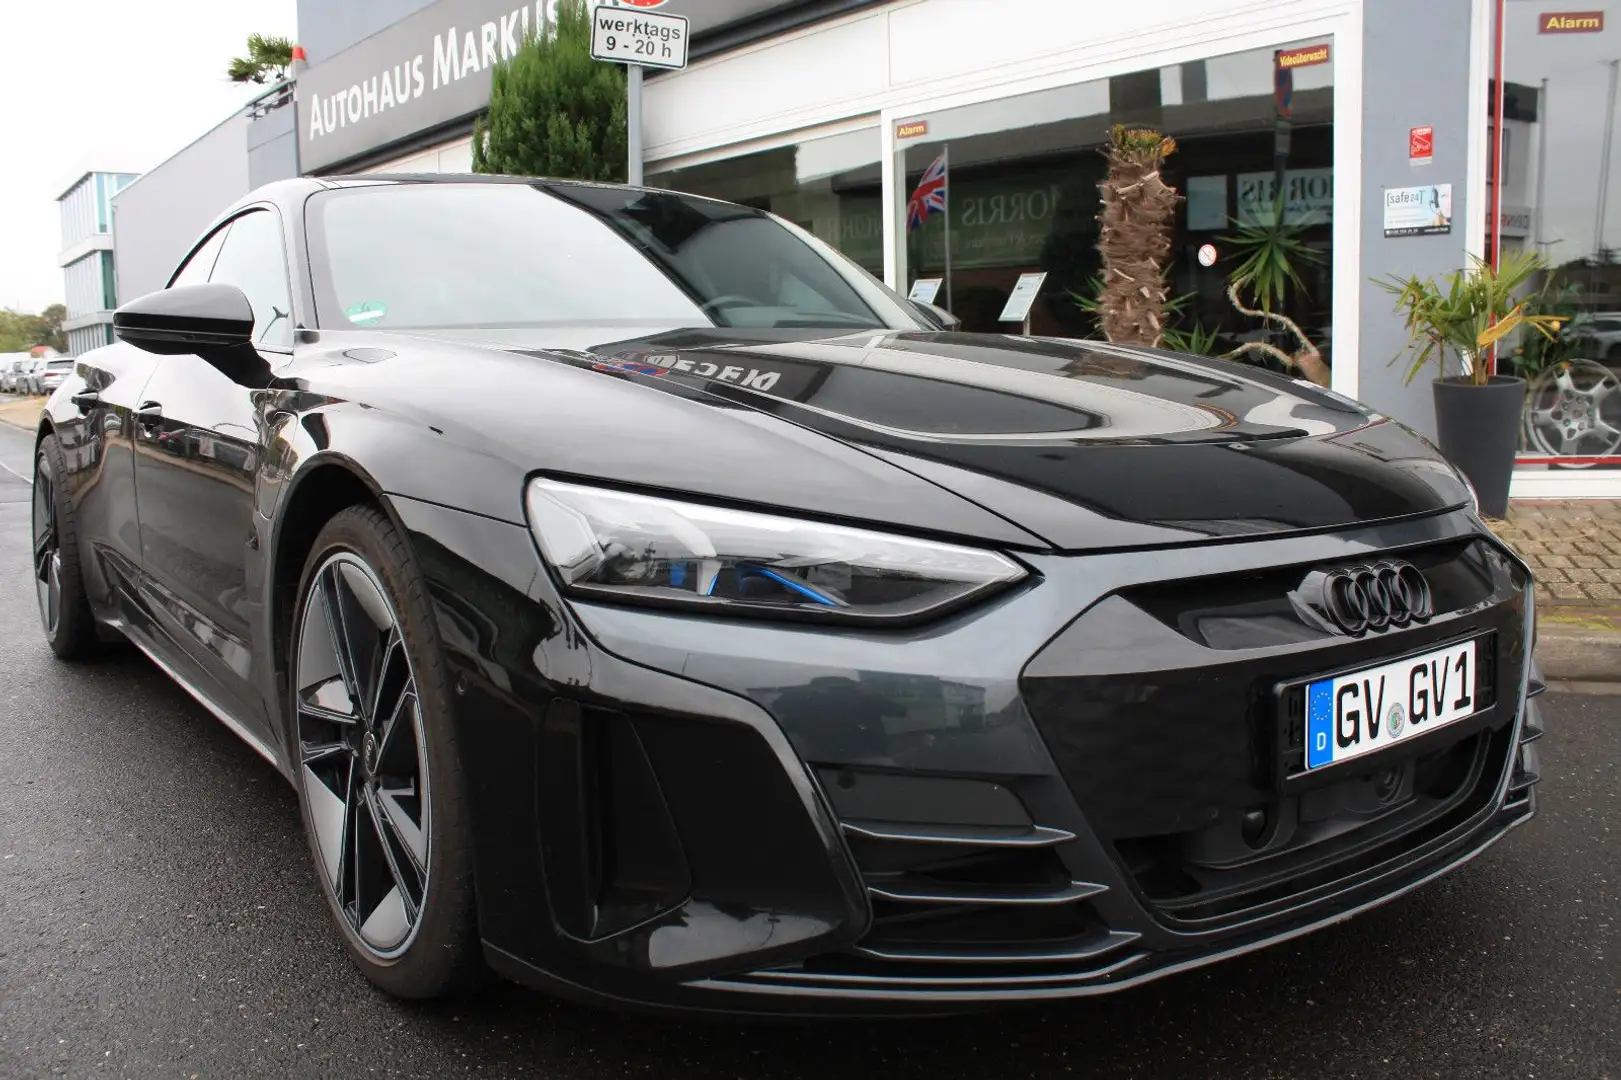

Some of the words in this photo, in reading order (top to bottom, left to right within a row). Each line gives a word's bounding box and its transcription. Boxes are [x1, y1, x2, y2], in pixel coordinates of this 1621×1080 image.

[599, 17, 681, 41] werktags
[1546, 15, 1600, 29] Alarm
[606, 36, 616, 51] 9
[635, 40, 655, 56] 20
[661, 44, 672, 58] h
[309, 52, 424, 141] AUTOHAUS
[432, 0, 558, 90] MARKUS
[899, 124, 925, 136] Alarm
[1337, 674, 1385, 748] GV
[1316, 732, 1327, 751] D
